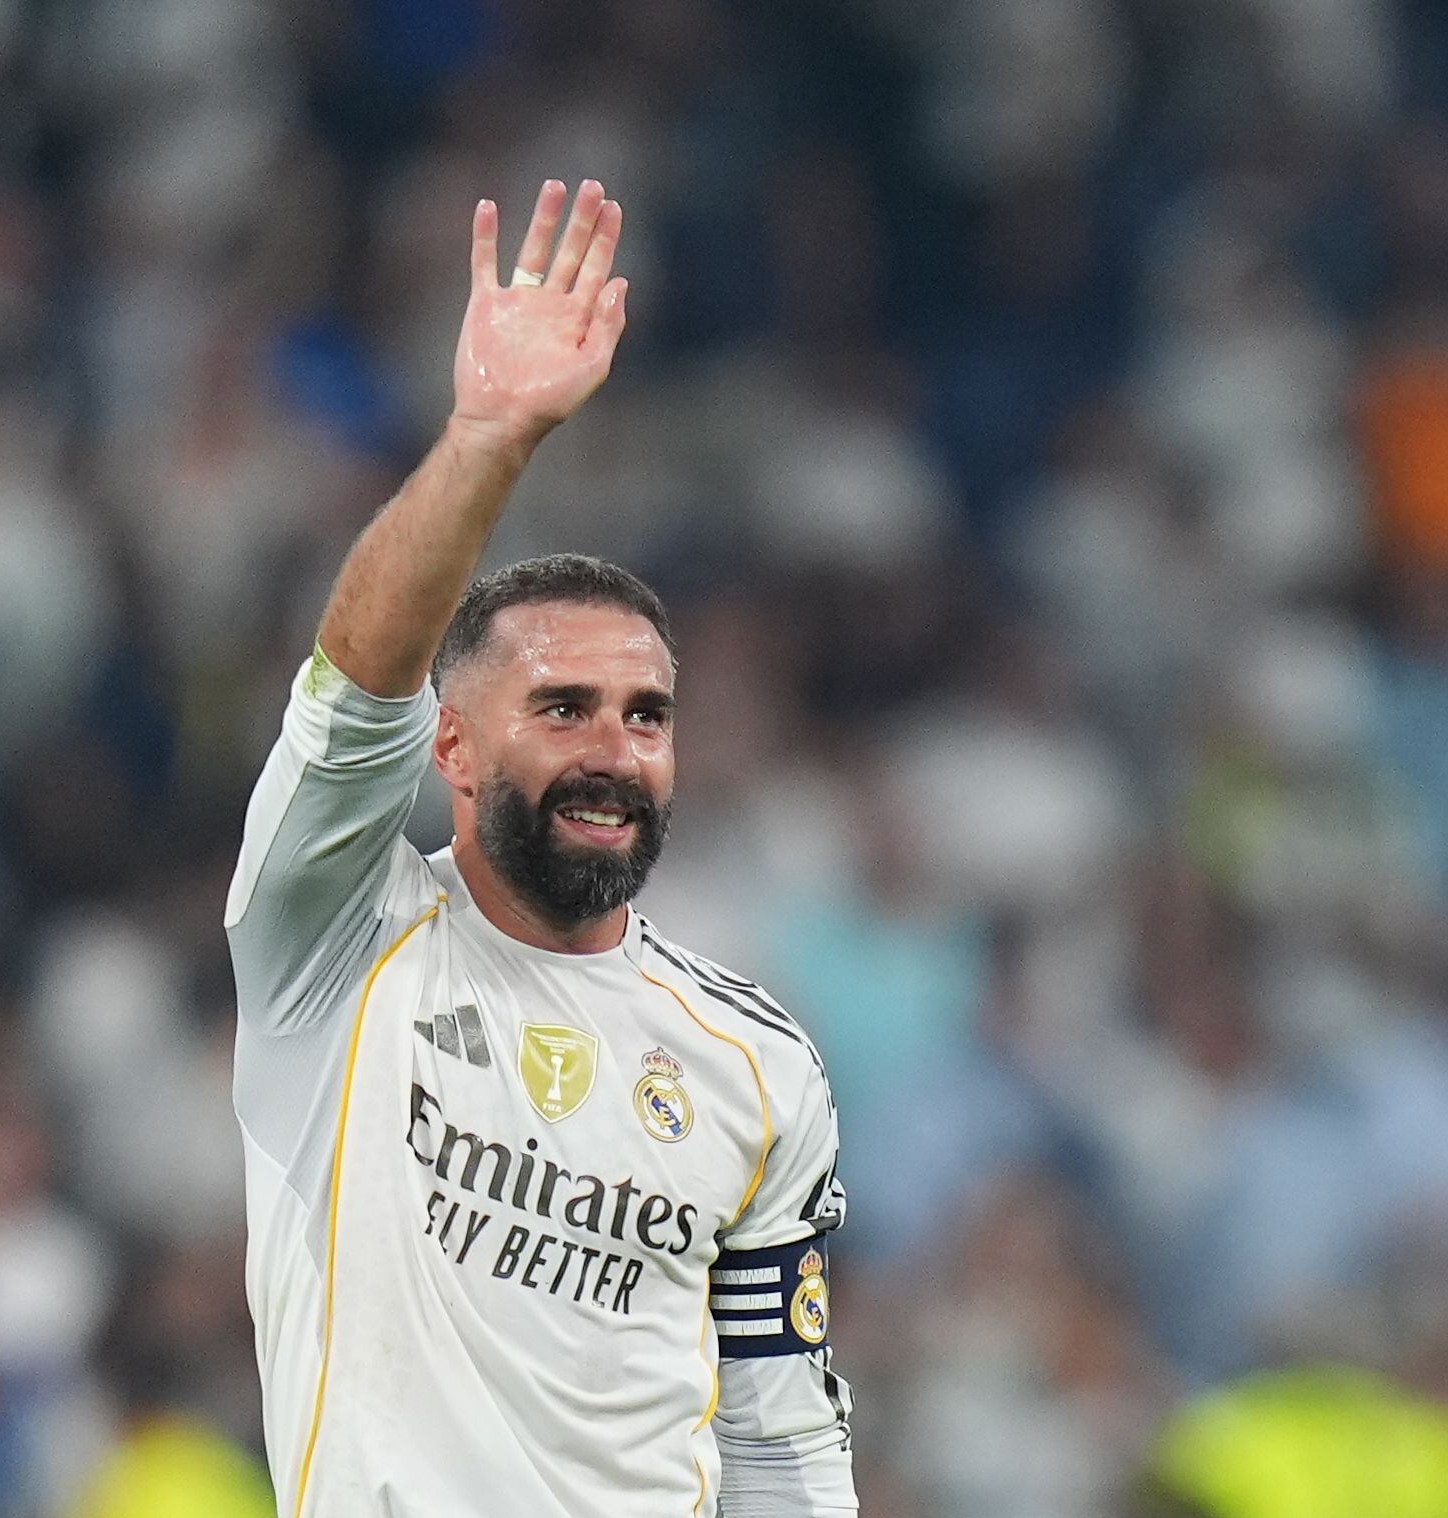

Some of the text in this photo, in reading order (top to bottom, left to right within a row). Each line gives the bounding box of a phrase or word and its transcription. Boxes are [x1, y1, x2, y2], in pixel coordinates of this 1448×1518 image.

[406, 1082, 698, 1255] Emirates
[425, 1190, 643, 1315] FLY BETTER
